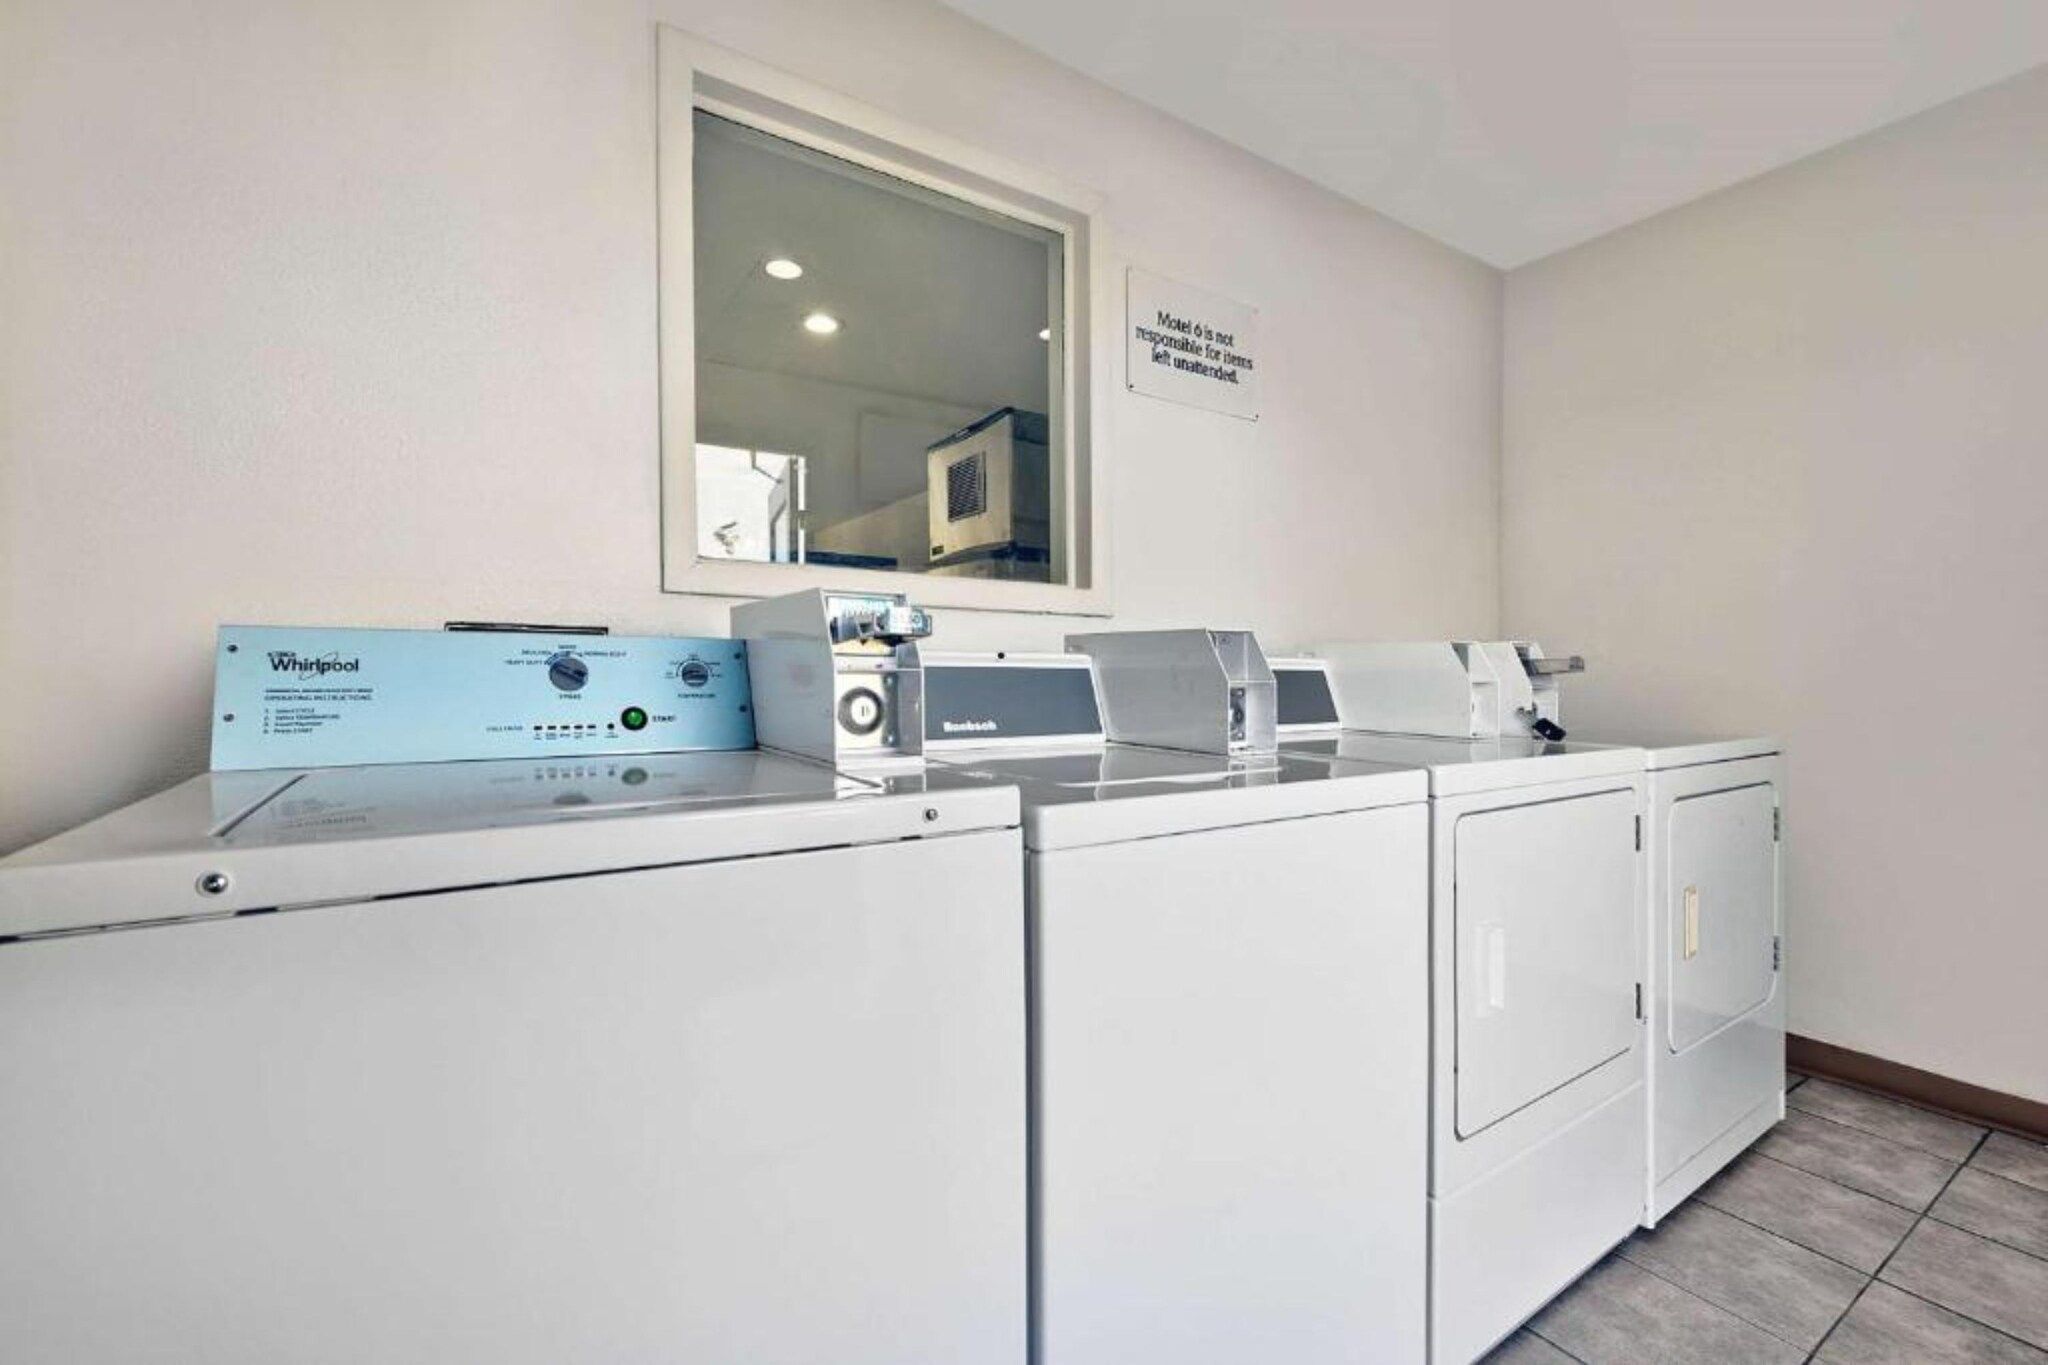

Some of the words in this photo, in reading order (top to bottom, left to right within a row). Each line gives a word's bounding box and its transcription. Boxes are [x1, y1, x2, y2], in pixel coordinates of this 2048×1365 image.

[1157, 310, 1192, 335] Motel
[1194, 322, 1203, 338] 6
[1204, 324, 1214, 341] is
[1215, 330, 1234, 347] not
[1135, 325, 1203, 357] responsible
[1205, 343, 1222, 361] for
[1223, 348, 1253, 371] items
[1151, 347, 1171, 367] left
[1173, 356, 1240, 385] unattended.
[270, 657, 359, 675] Whirlpool
